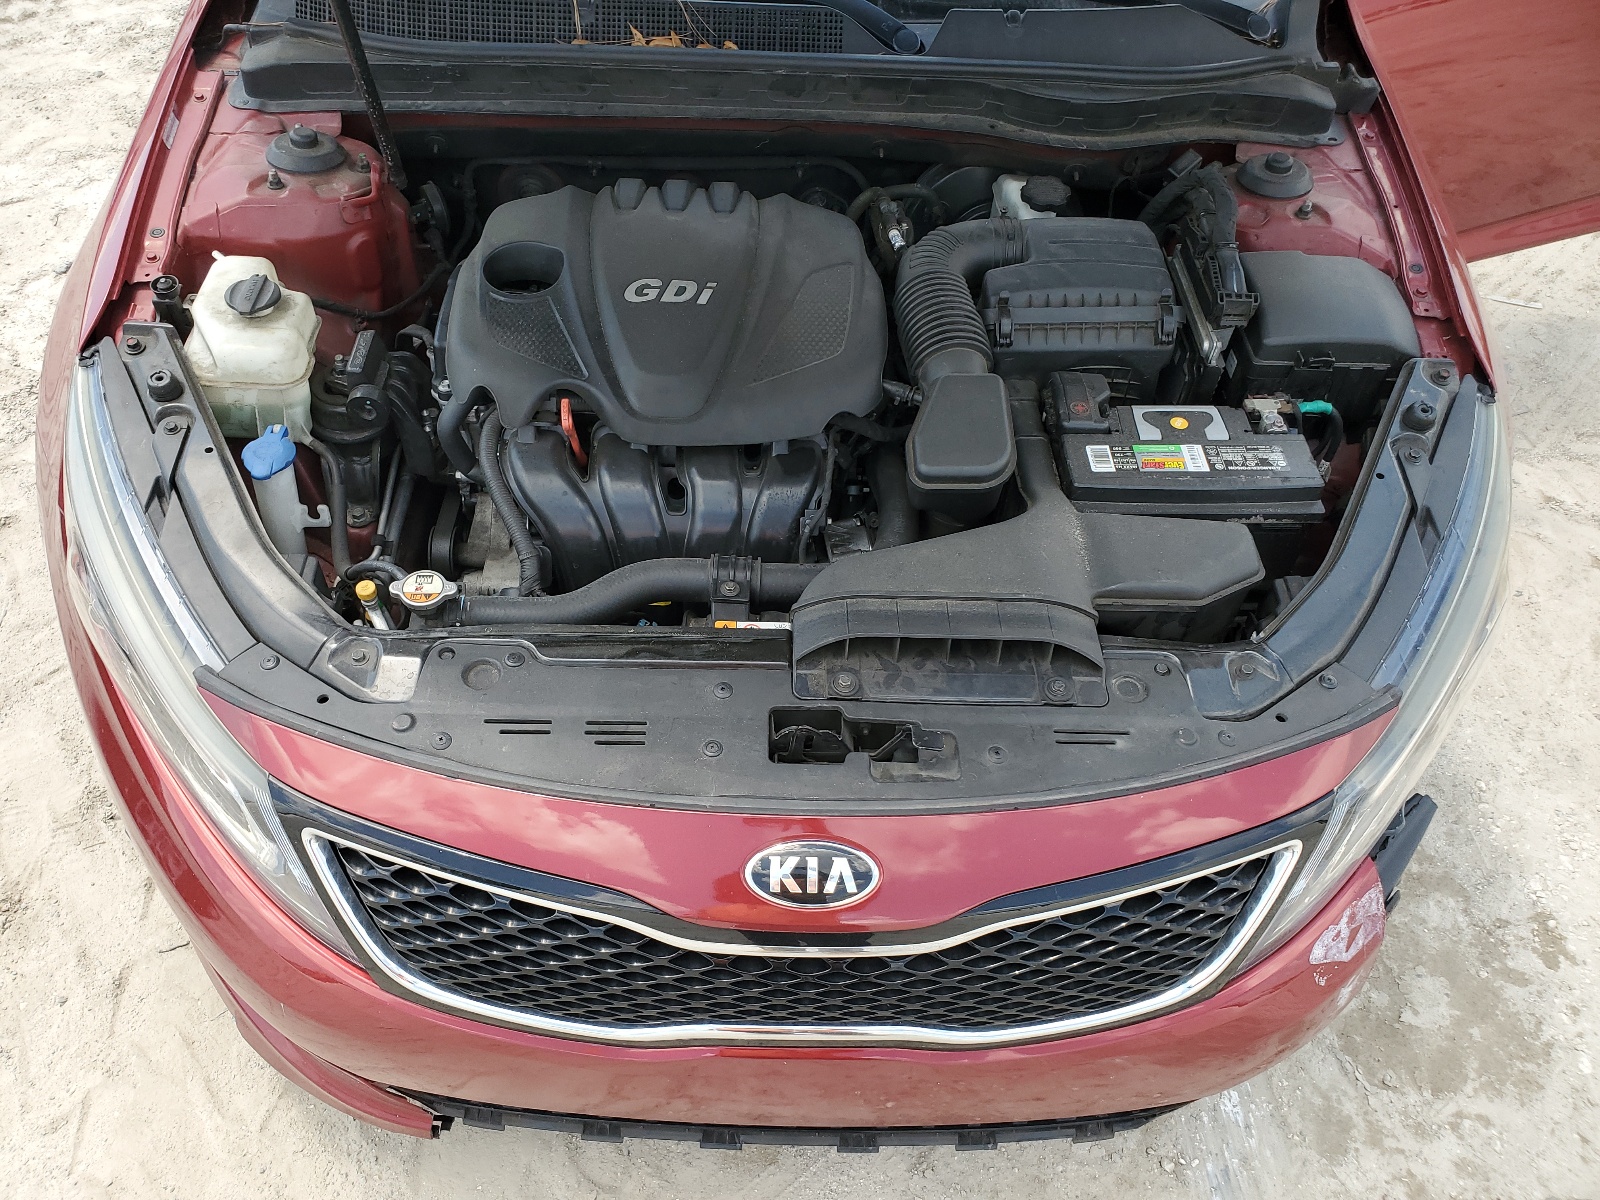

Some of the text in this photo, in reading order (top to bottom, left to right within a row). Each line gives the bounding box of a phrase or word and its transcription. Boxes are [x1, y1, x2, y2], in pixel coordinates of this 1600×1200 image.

[623, 278, 718, 305] GDi
[1142, 461, 1185, 470] EverStart
[768, 855, 858, 894] KIA
